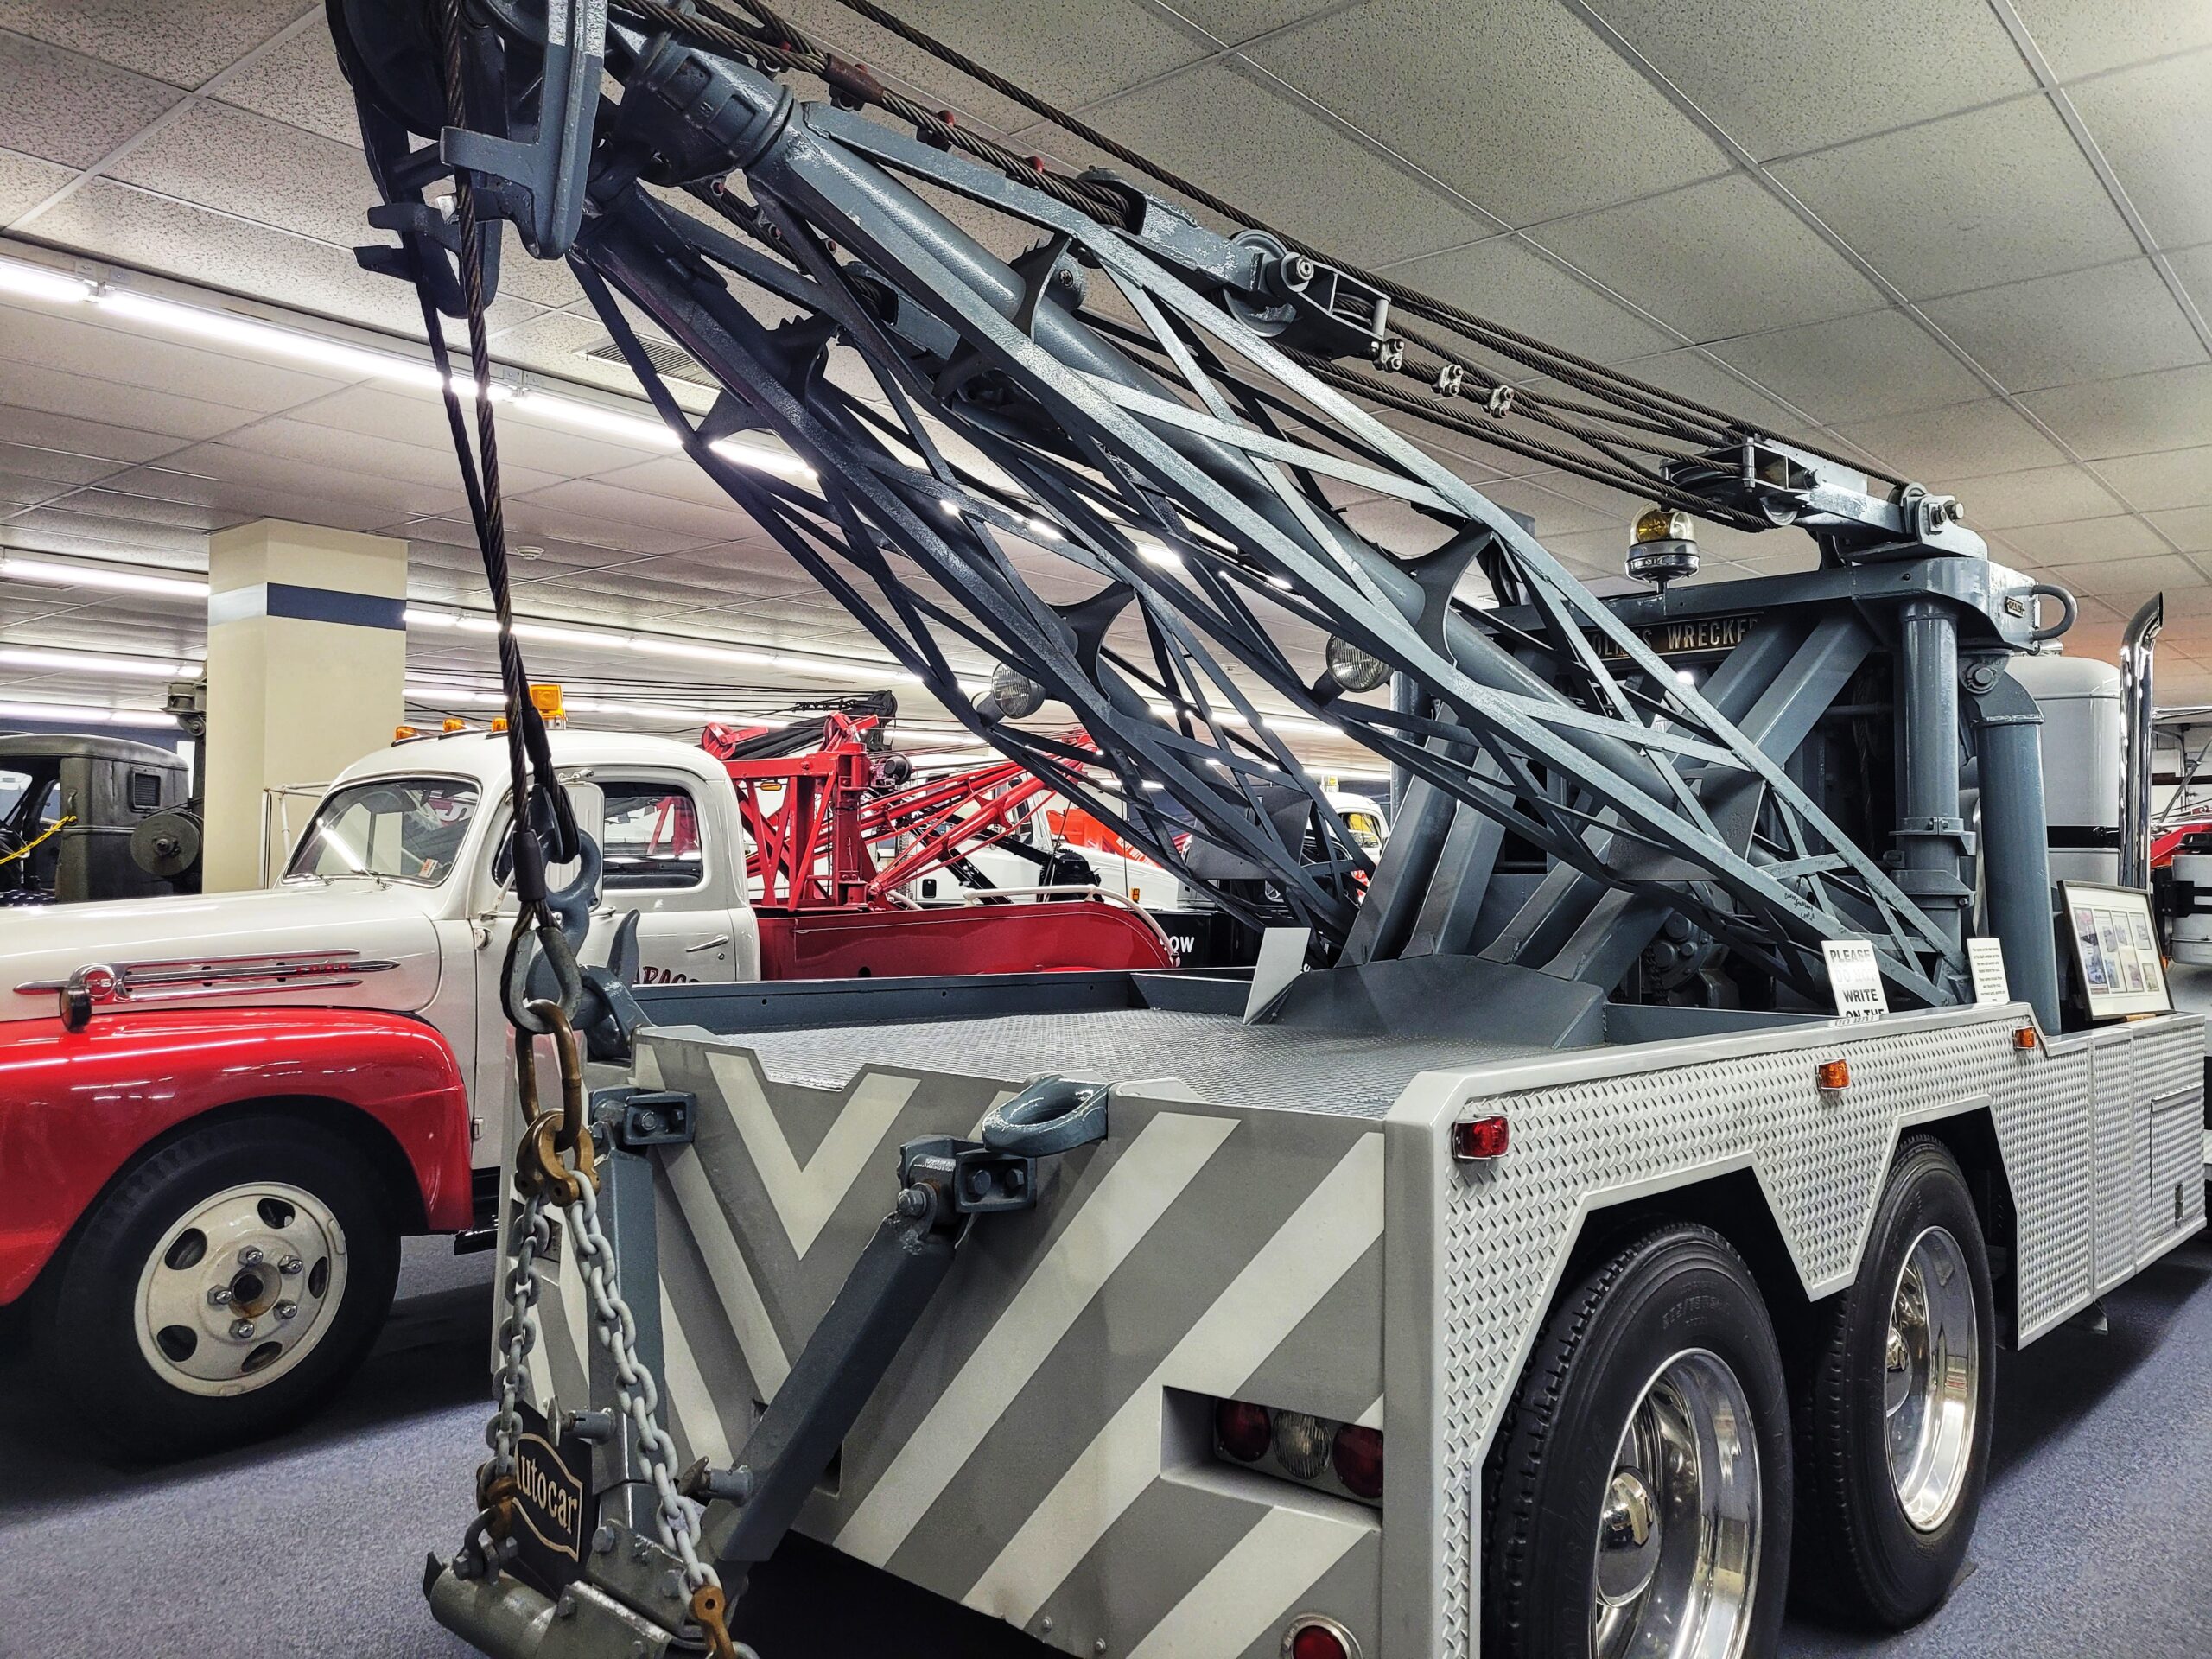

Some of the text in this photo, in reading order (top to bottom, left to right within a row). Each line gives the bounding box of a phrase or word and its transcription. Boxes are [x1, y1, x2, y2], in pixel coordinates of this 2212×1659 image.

[1592, 628, 1652, 656] OLS
[1169, 935, 1195, 953] OW
[1830, 949, 1871, 963] PLEASE
[1843, 988, 1878, 1003] WRITE
